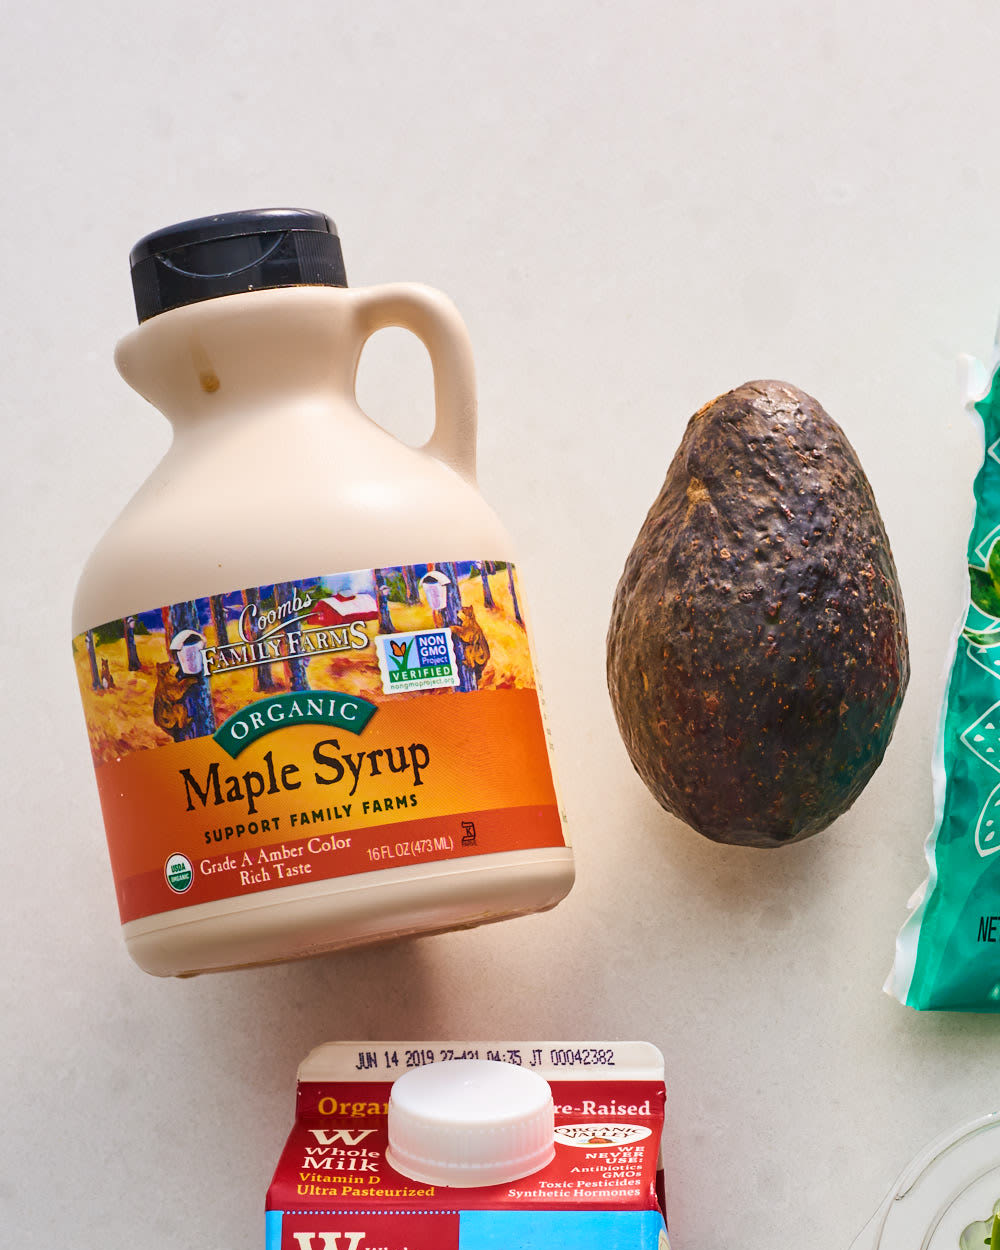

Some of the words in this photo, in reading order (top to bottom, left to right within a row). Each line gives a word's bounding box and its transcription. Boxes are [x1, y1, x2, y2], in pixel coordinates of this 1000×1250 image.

[238, 588, 312, 643] Coombs
[419, 635, 445, 646] NON
[200, 638, 282, 677] FAMILY
[287, 620, 370, 654] FARMS
[420, 645, 447, 657] GMO
[422, 656, 448, 665] Project
[392, 666, 451, 680] VERIFIED
[230, 698, 358, 740] ORGANIC
[178, 750, 302, 815] Maple
[312, 739, 431, 796] Syrup
[204, 817, 280, 844] SUPPORT
[290, 804, 352, 827] FAMILY
[362, 793, 418, 815] FARMS
[200, 855, 237, 875] Grade
[241, 852, 254, 868] A
[257, 844, 304, 865] Amber
[307, 835, 352, 855] Color
[367, 847, 380, 861] 16
[380, 845, 395, 859] FL
[395, 842, 411, 857] OZ
[411, 838, 433, 856] (473
[433, 835, 454, 851] ML)
[170, 862, 186, 873] USDA
[239, 865, 271, 887] Rich
[273, 861, 312, 881] Taste
[355, 1052, 378, 1070] JUN
[384, 1051, 399, 1068] 14
[405, 1049, 434, 1067] 2019
[550, 1049, 615, 1066] 00042382
[553, 1100, 651, 1116] re-Raised
[308, 1129, 378, 1146] W
[305, 1147, 380, 1158] Whole
[301, 1157, 379, 1172] Milk
[570, 1164, 643, 1173] Antibiotics
[299, 1173, 364, 1184] Vitamin
[368, 1176, 381, 1184] D
[602, 1171, 642, 1179] GMOs
[297, 1184, 337, 1196] Ultra
[341, 1186, 435, 1197] Pasteurized
[539, 1181, 574, 1189] Toxic
[577, 1179, 641, 1188] Pesticides
[508, 1189, 571, 1199] Synthetic
[573, 1189, 641, 1198] Hormones
